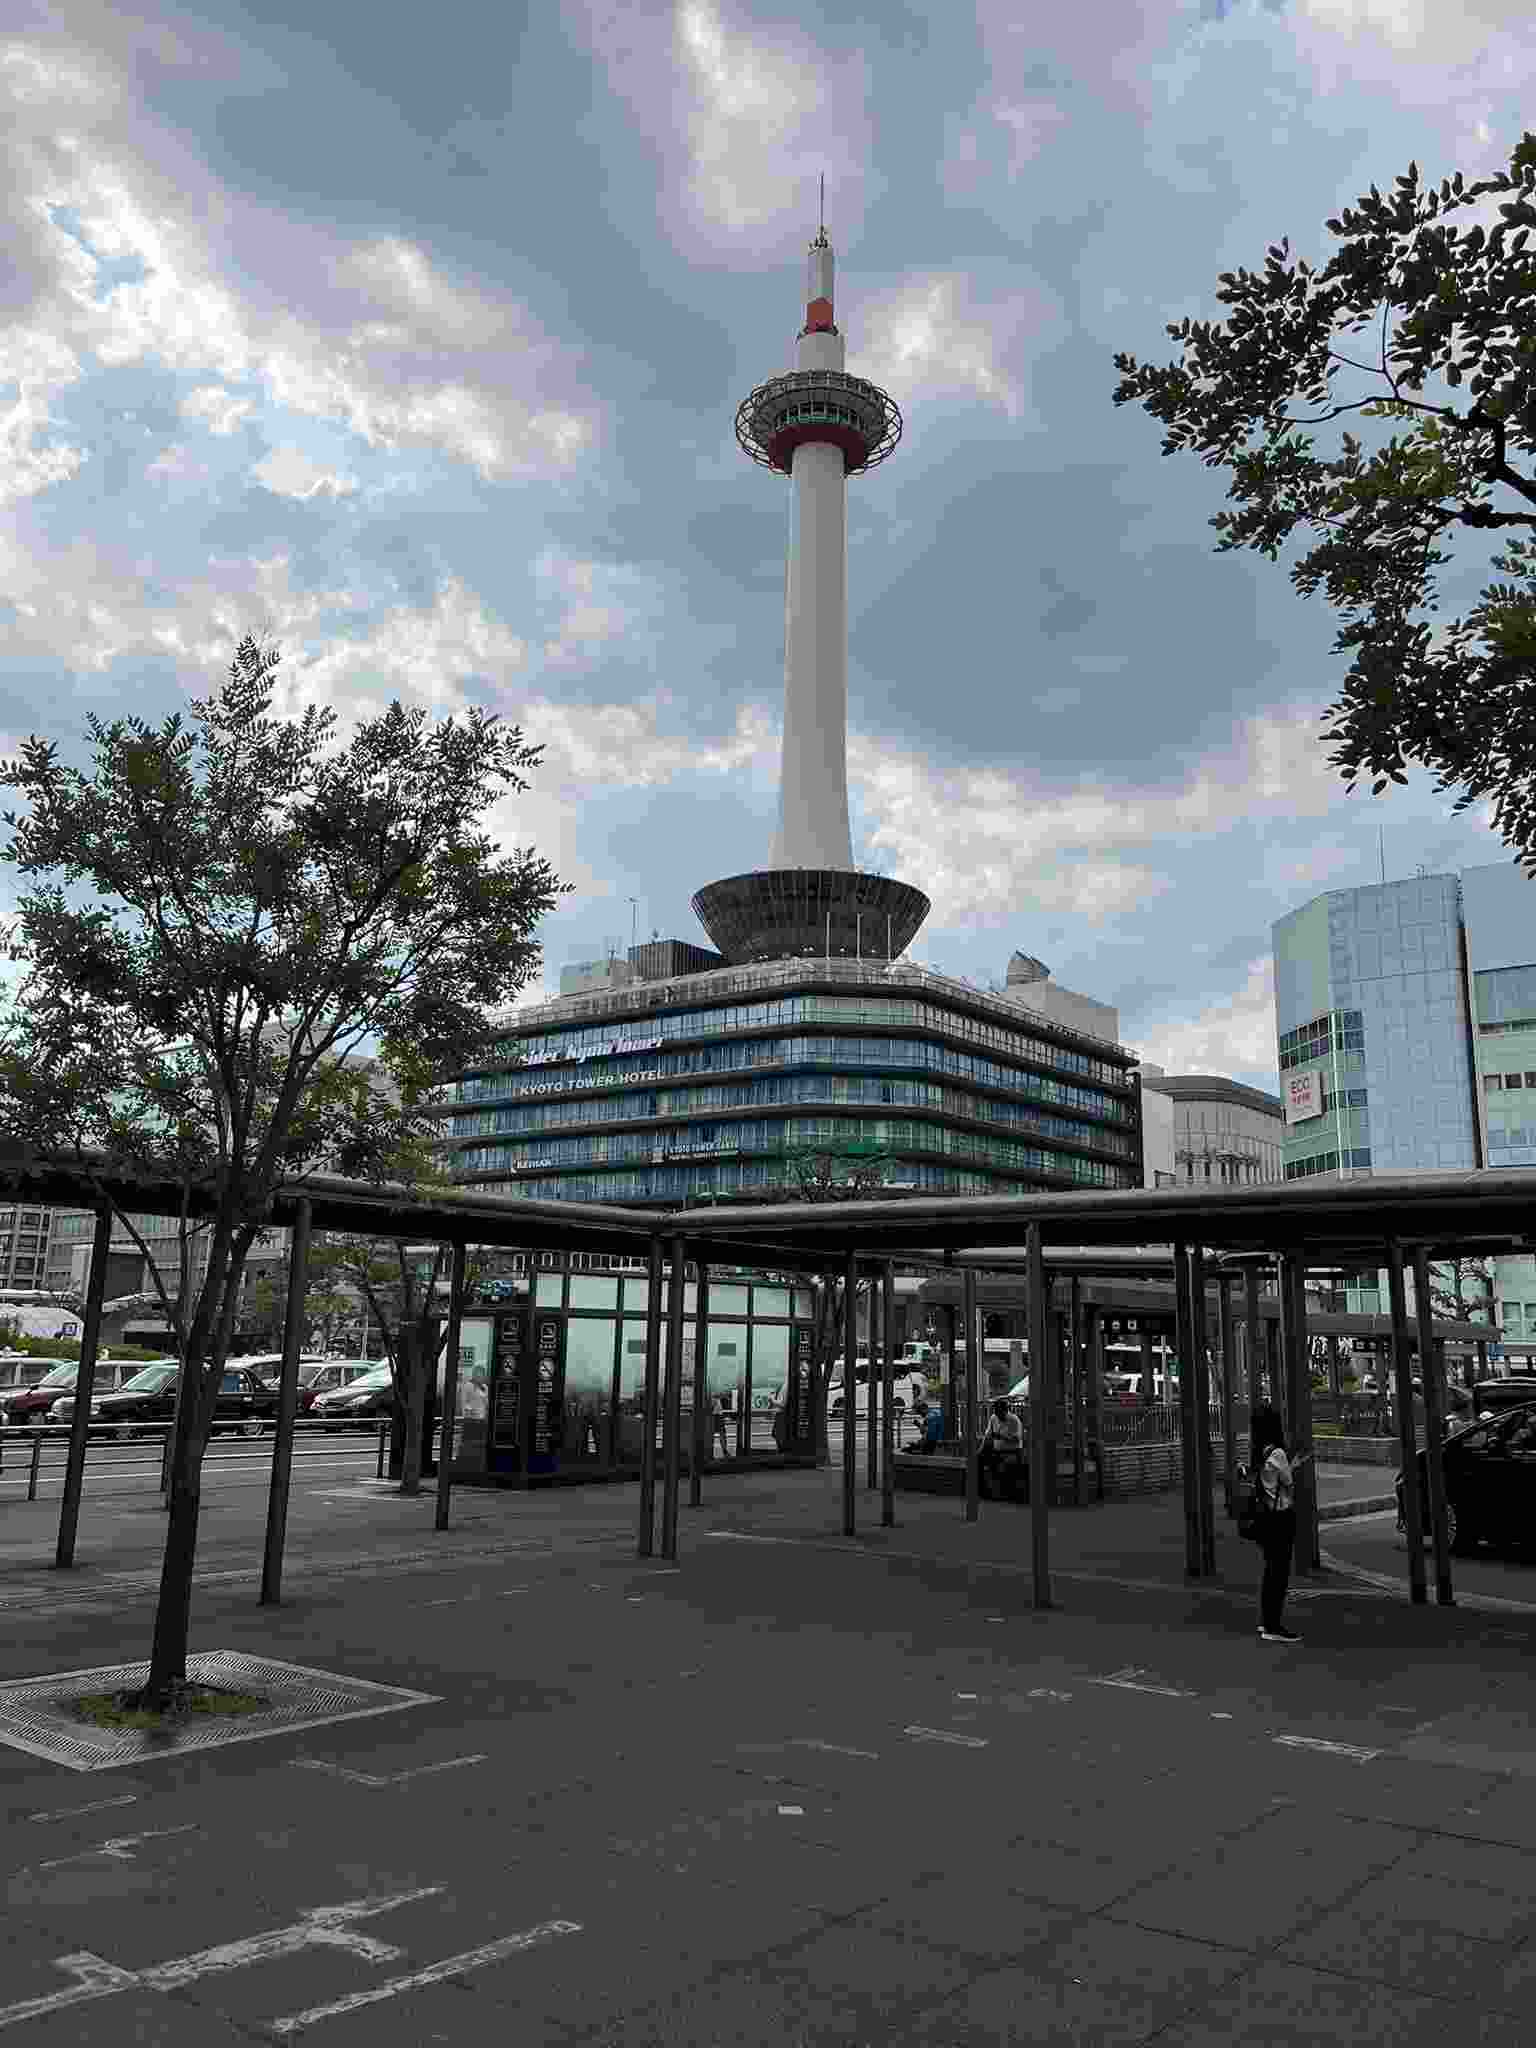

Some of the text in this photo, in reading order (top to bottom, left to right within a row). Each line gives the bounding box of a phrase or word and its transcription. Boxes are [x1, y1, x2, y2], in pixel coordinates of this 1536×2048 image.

[520, 1068, 664, 1096] KYOTO TOWER HOTEL
